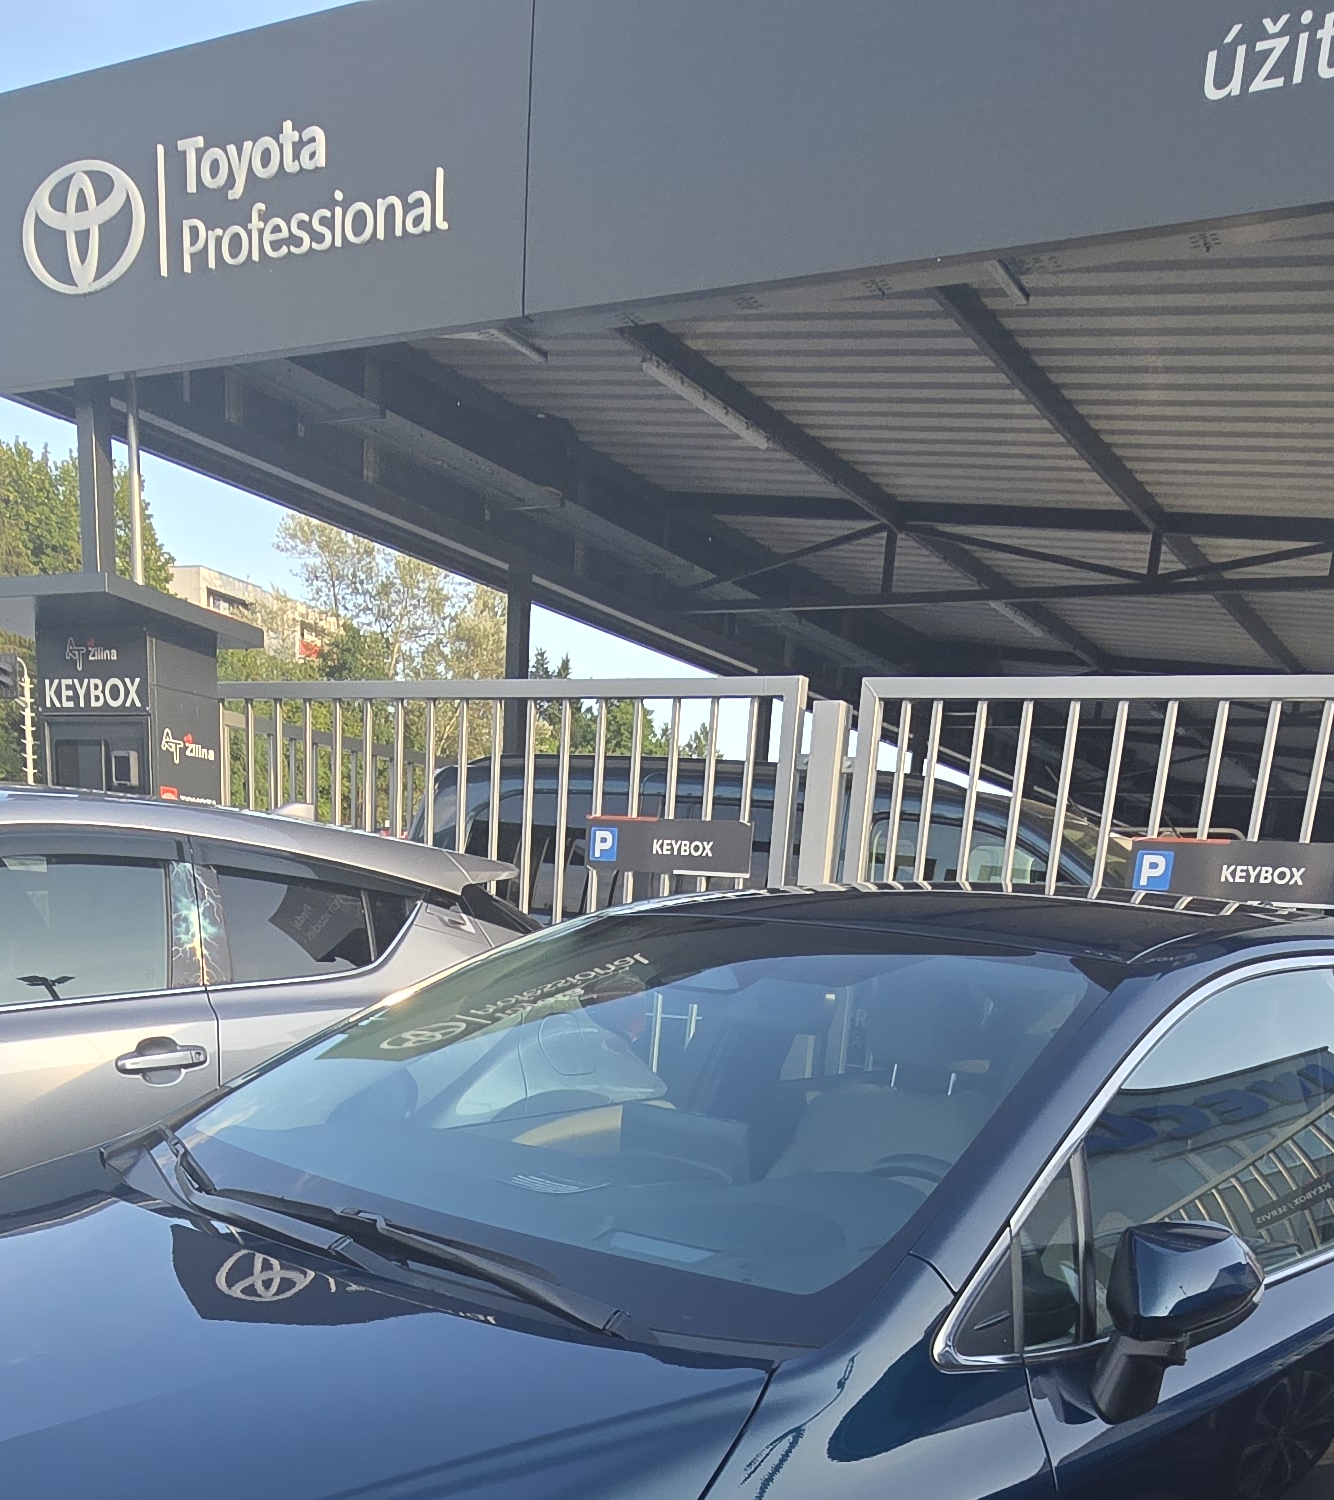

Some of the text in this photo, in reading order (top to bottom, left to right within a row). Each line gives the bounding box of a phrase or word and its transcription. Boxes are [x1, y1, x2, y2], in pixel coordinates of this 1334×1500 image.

[176, 119, 326, 200] Toyota
[182, 166, 449, 274] Professional
[44, 677, 142, 708] KEYBOX
[594, 830, 714, 858] P KEYBOX
[1139, 854, 1306, 886] P KEYBOX
